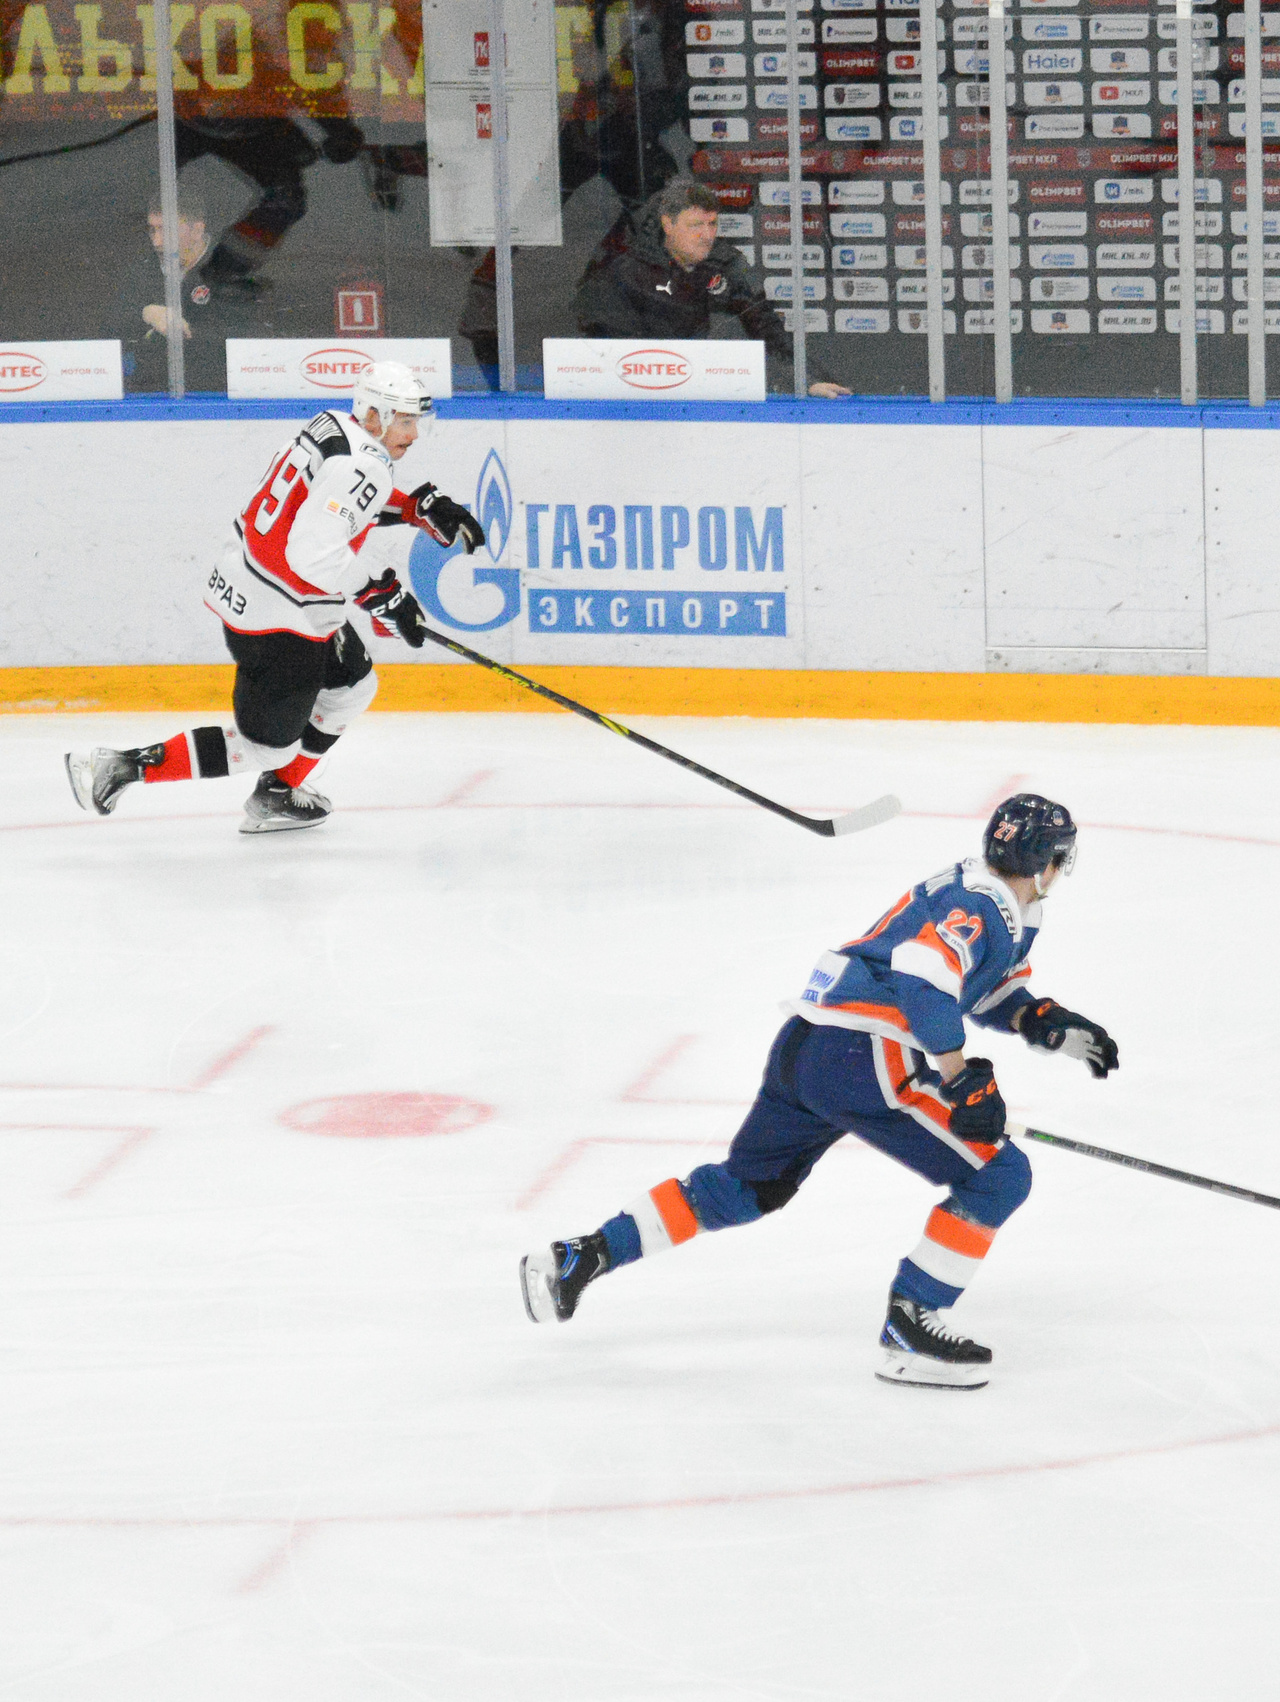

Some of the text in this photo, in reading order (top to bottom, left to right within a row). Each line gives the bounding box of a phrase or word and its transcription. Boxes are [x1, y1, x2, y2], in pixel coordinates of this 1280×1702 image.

[1028, 54, 1076, 69] Haier
[60, 367, 108, 375] MOTOR OIL
[240, 365, 287, 373] MOTOR OIL
[422, 365, 437, 373] OIL
[556, 366, 603, 374] MOTOR OIL
[621, 363, 687, 376] SINTEC
[705, 367, 751, 375] MOTOR OIL
[348, 468, 378, 512] 79
[525, 503, 785, 572] ГАЗПРОМ
[538, 597, 774, 629] ЭКСПОРТ
[993, 820, 1019, 842] 27
[943, 908, 983, 946] 27
